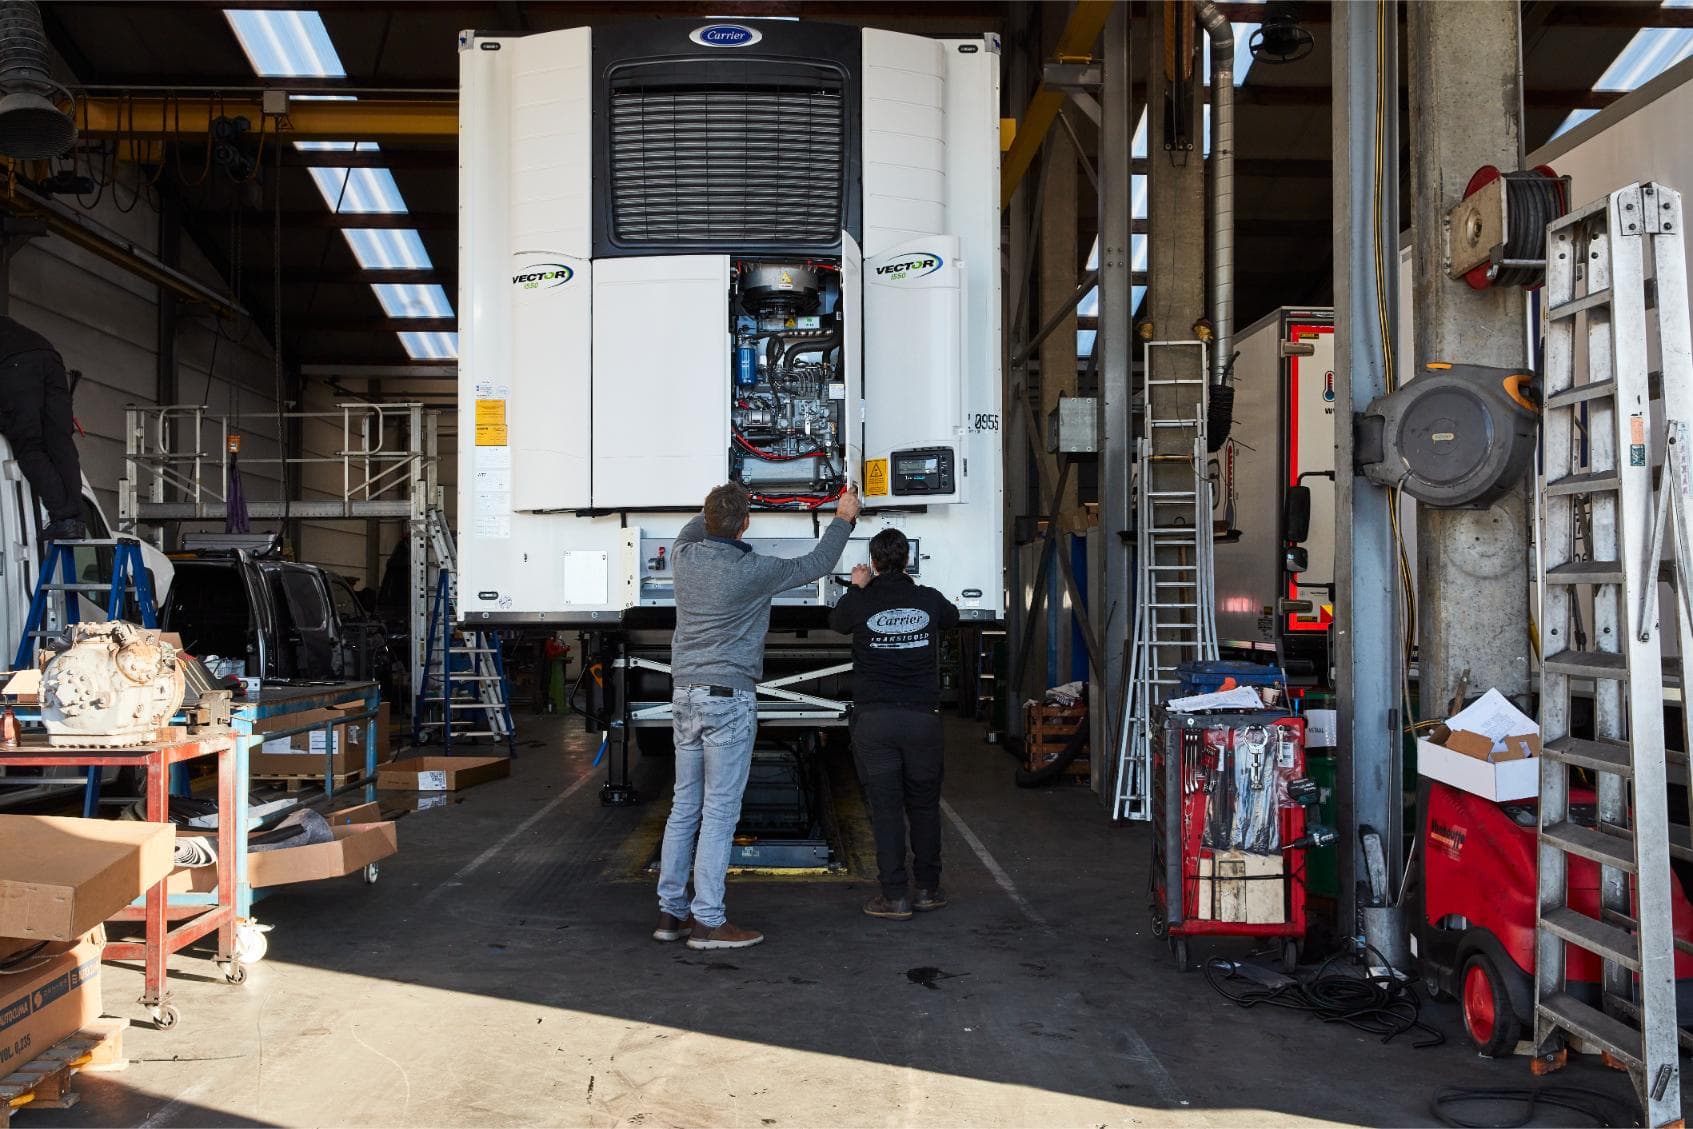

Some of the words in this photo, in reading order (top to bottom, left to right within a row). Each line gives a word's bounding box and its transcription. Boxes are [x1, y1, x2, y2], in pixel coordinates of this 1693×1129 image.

[707, 30, 745, 40] Carrier
[876, 259, 935, 275] VECTOR
[512, 270, 566, 284] VECTOR
[974, 413, 999, 431] 0955
[876, 615, 923, 627] Carrier
